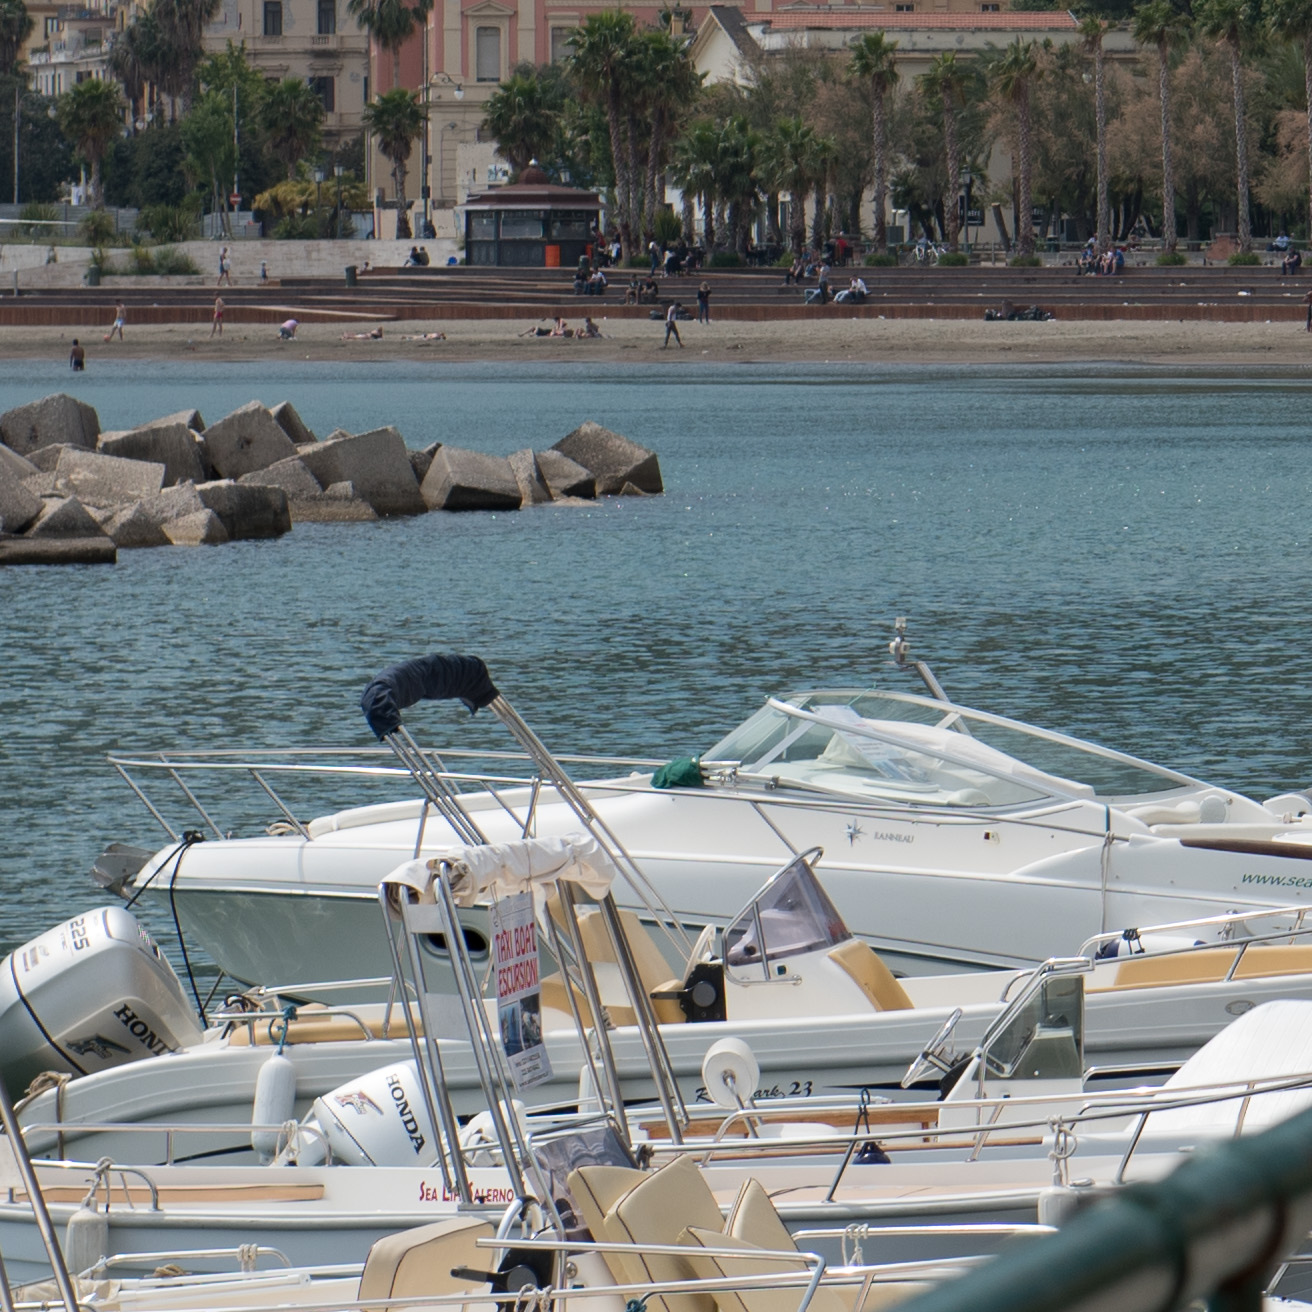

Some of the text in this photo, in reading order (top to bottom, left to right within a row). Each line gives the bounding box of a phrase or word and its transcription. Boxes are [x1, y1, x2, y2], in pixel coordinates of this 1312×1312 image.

[71, 918, 90, 951] 225
[495, 921, 537, 963] TAXI BOAT
[788, 1080, 813, 1097] 23
[385, 1072, 427, 1155] HONDA
[419, 1180, 438, 1202] SEA
